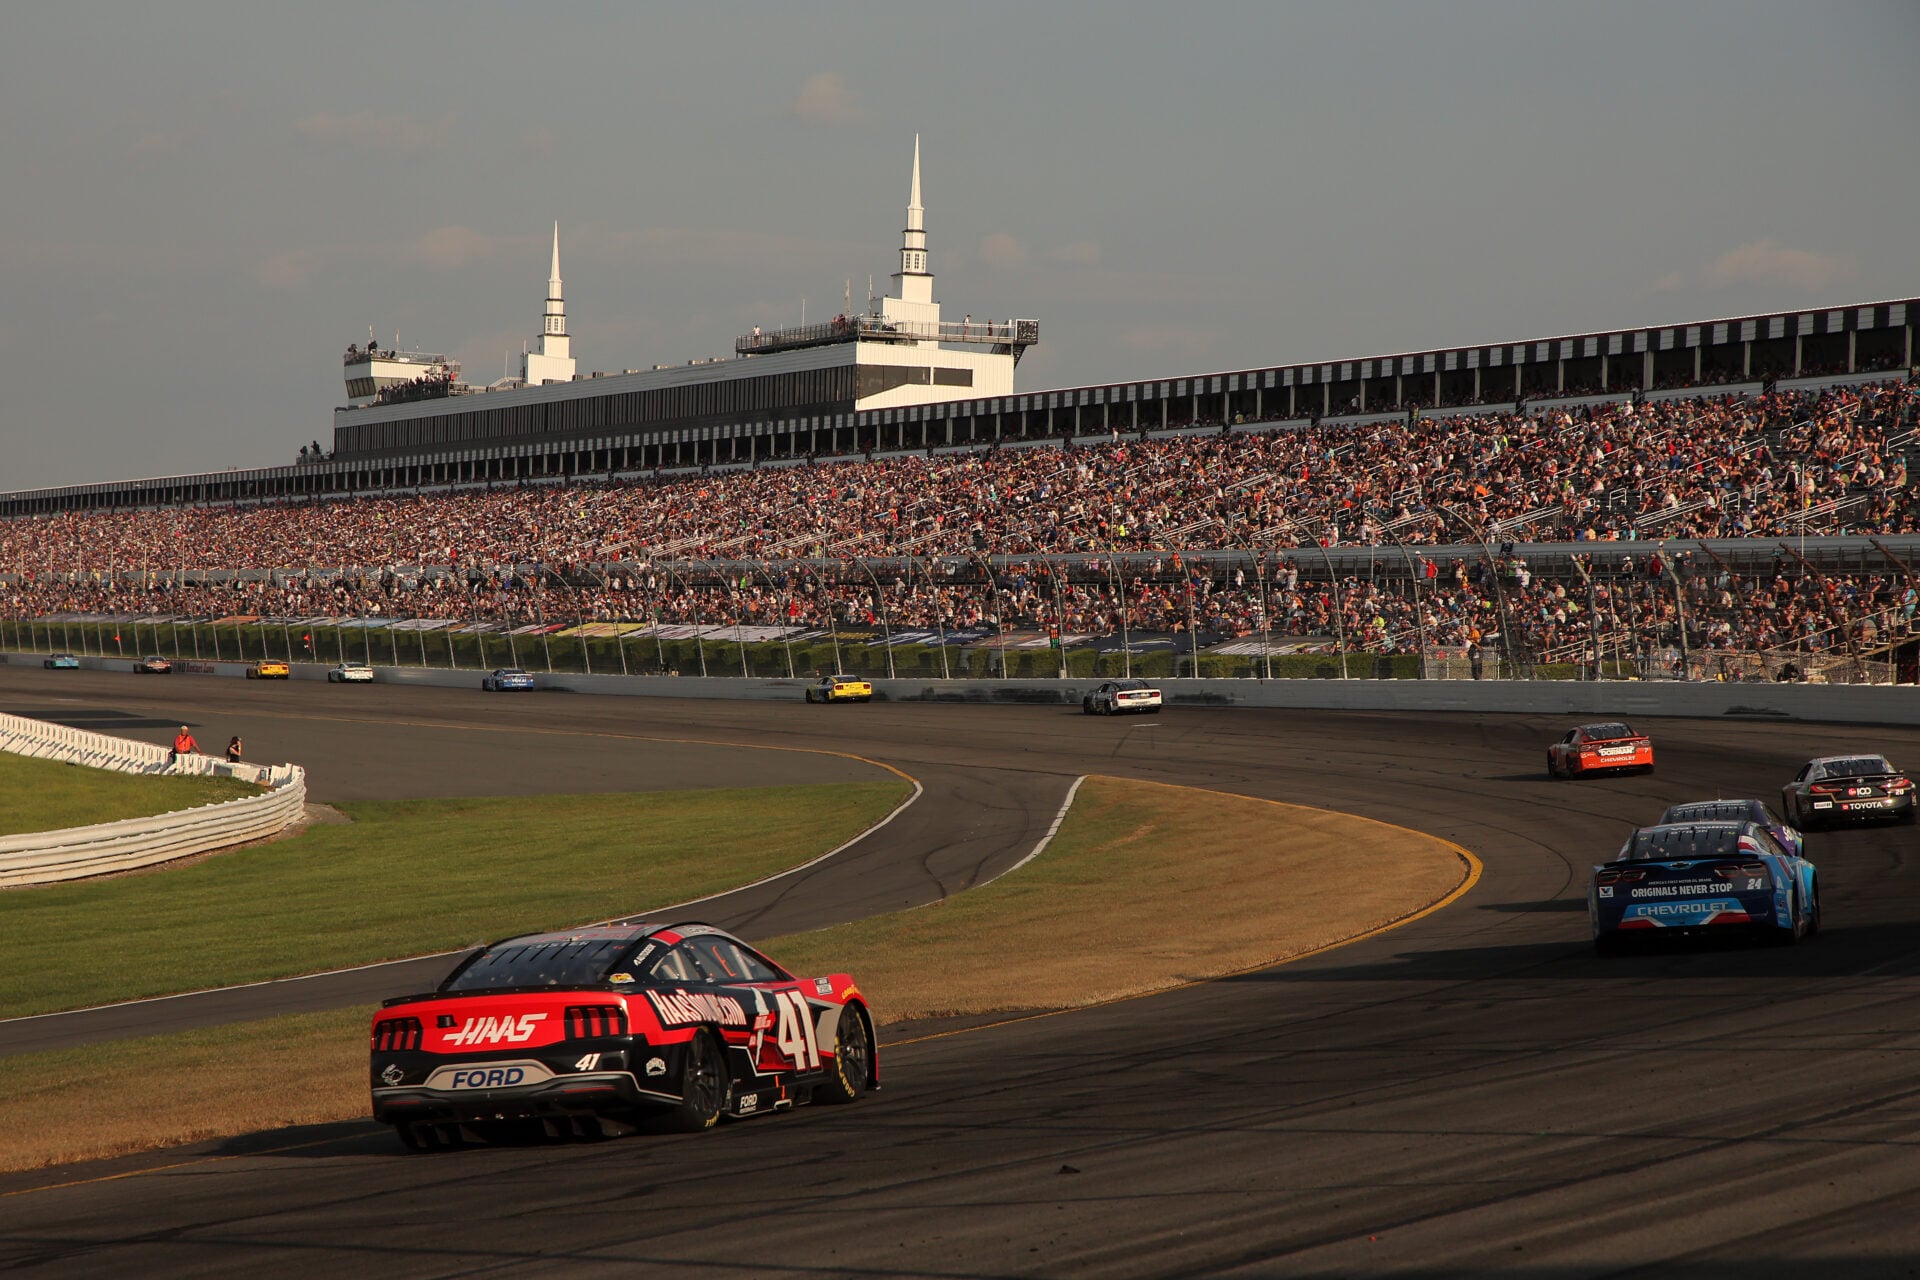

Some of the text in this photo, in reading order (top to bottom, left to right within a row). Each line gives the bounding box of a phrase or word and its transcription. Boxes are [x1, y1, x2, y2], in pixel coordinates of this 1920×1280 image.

[1850, 802, 1883, 810] TOYOTA
[1631, 882, 1733, 898] ORIGINALS NEVER STOP
[1747, 879, 1762, 890] 24
[1637, 902, 1729, 917] CHEVROLET
[443, 1013, 548, 1047] HAAS
[774, 989, 823, 1073] 41
[575, 1052, 601, 1071] 41
[452, 1067, 524, 1089] FORD
[740, 1093, 758, 1108] FORD
